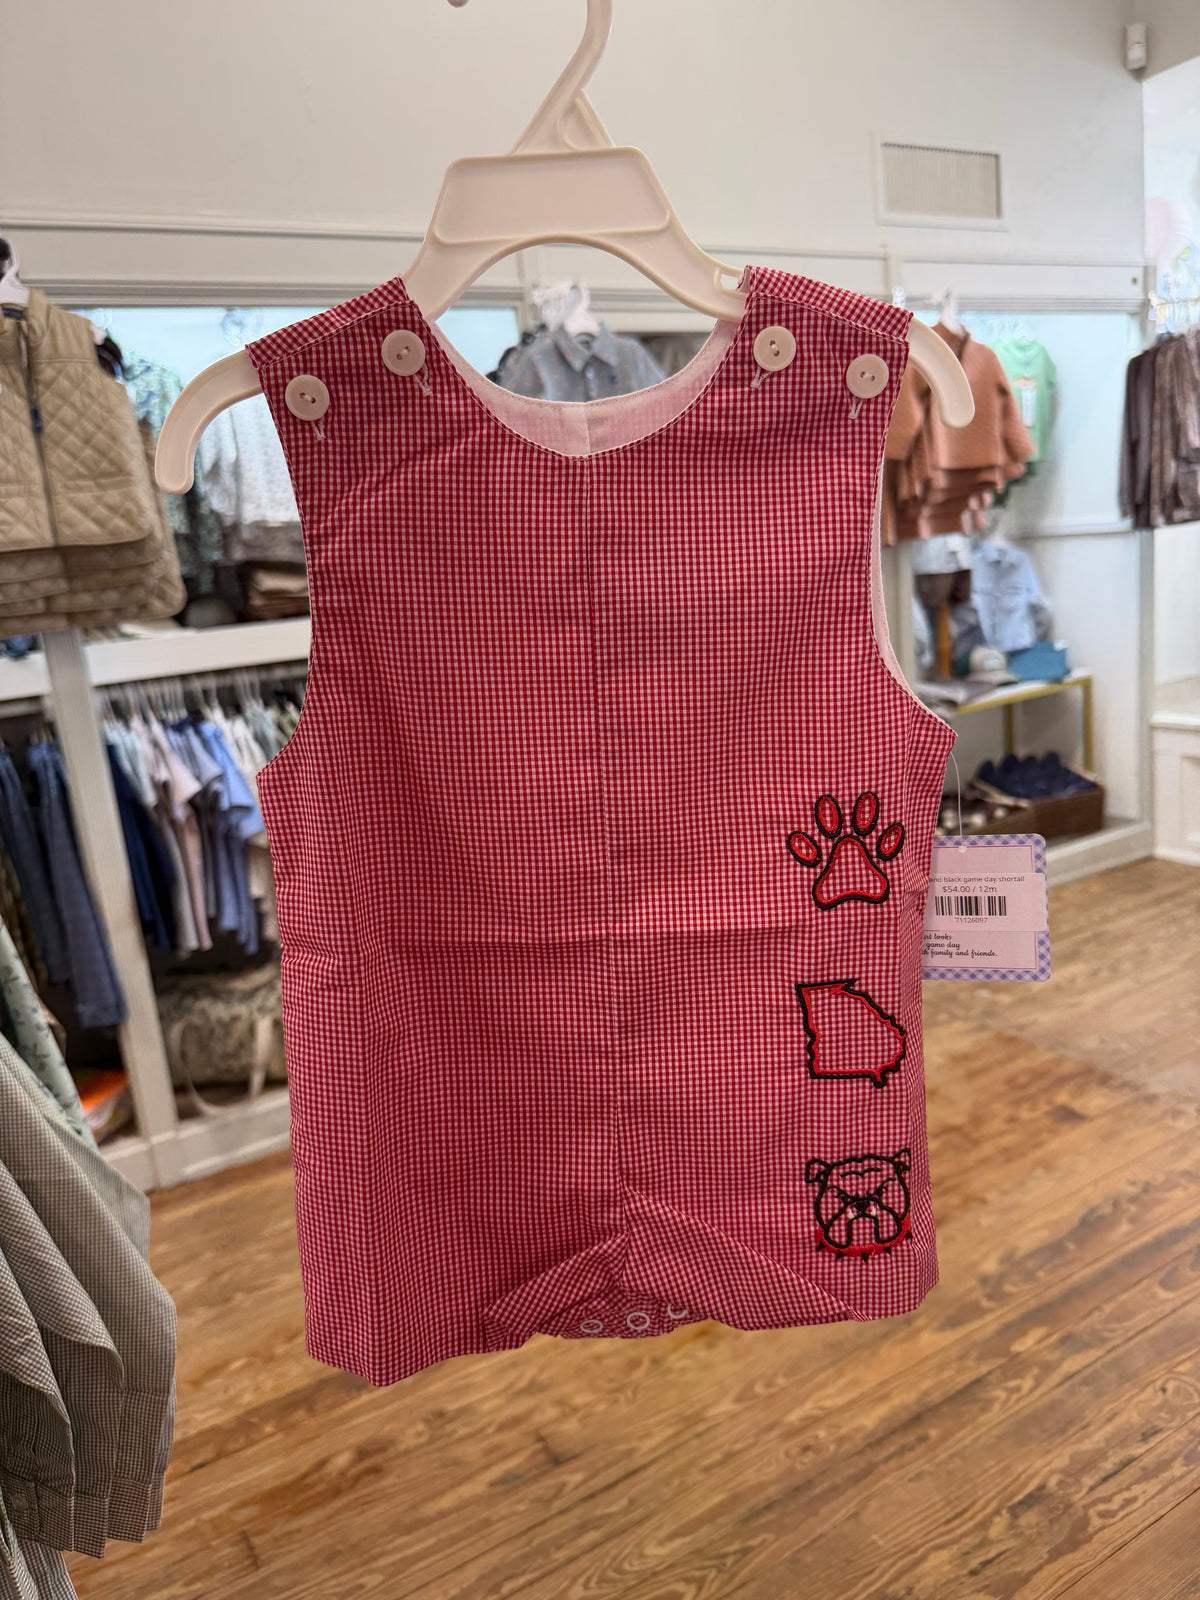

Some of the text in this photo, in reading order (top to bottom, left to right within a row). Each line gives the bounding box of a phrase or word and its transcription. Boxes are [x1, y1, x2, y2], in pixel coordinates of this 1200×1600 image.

[984, 876, 997, 884] day
[926, 942, 961, 950] game day
[930, 949, 953, 958] family
[971, 950, 998, 958] friends.
